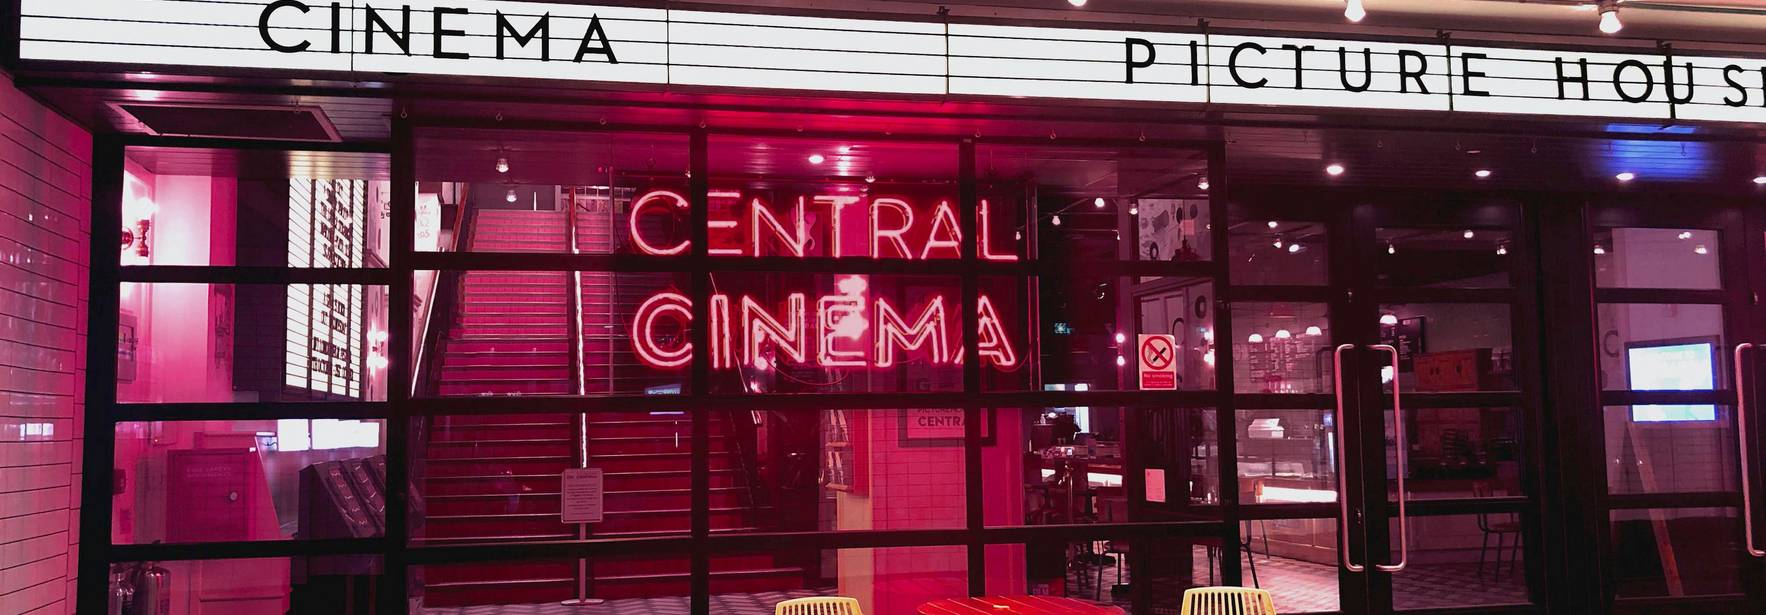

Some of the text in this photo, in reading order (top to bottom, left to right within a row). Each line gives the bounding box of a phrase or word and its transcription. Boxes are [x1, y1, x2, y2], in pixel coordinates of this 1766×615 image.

[258, 0, 619, 64] CINEMA
[1125, 37, 1490, 97] PICTURE
[629, 190, 1018, 261] CENTRAL
[632, 291, 1016, 370] CINEMA
[918, 416, 964, 426] CENTR
